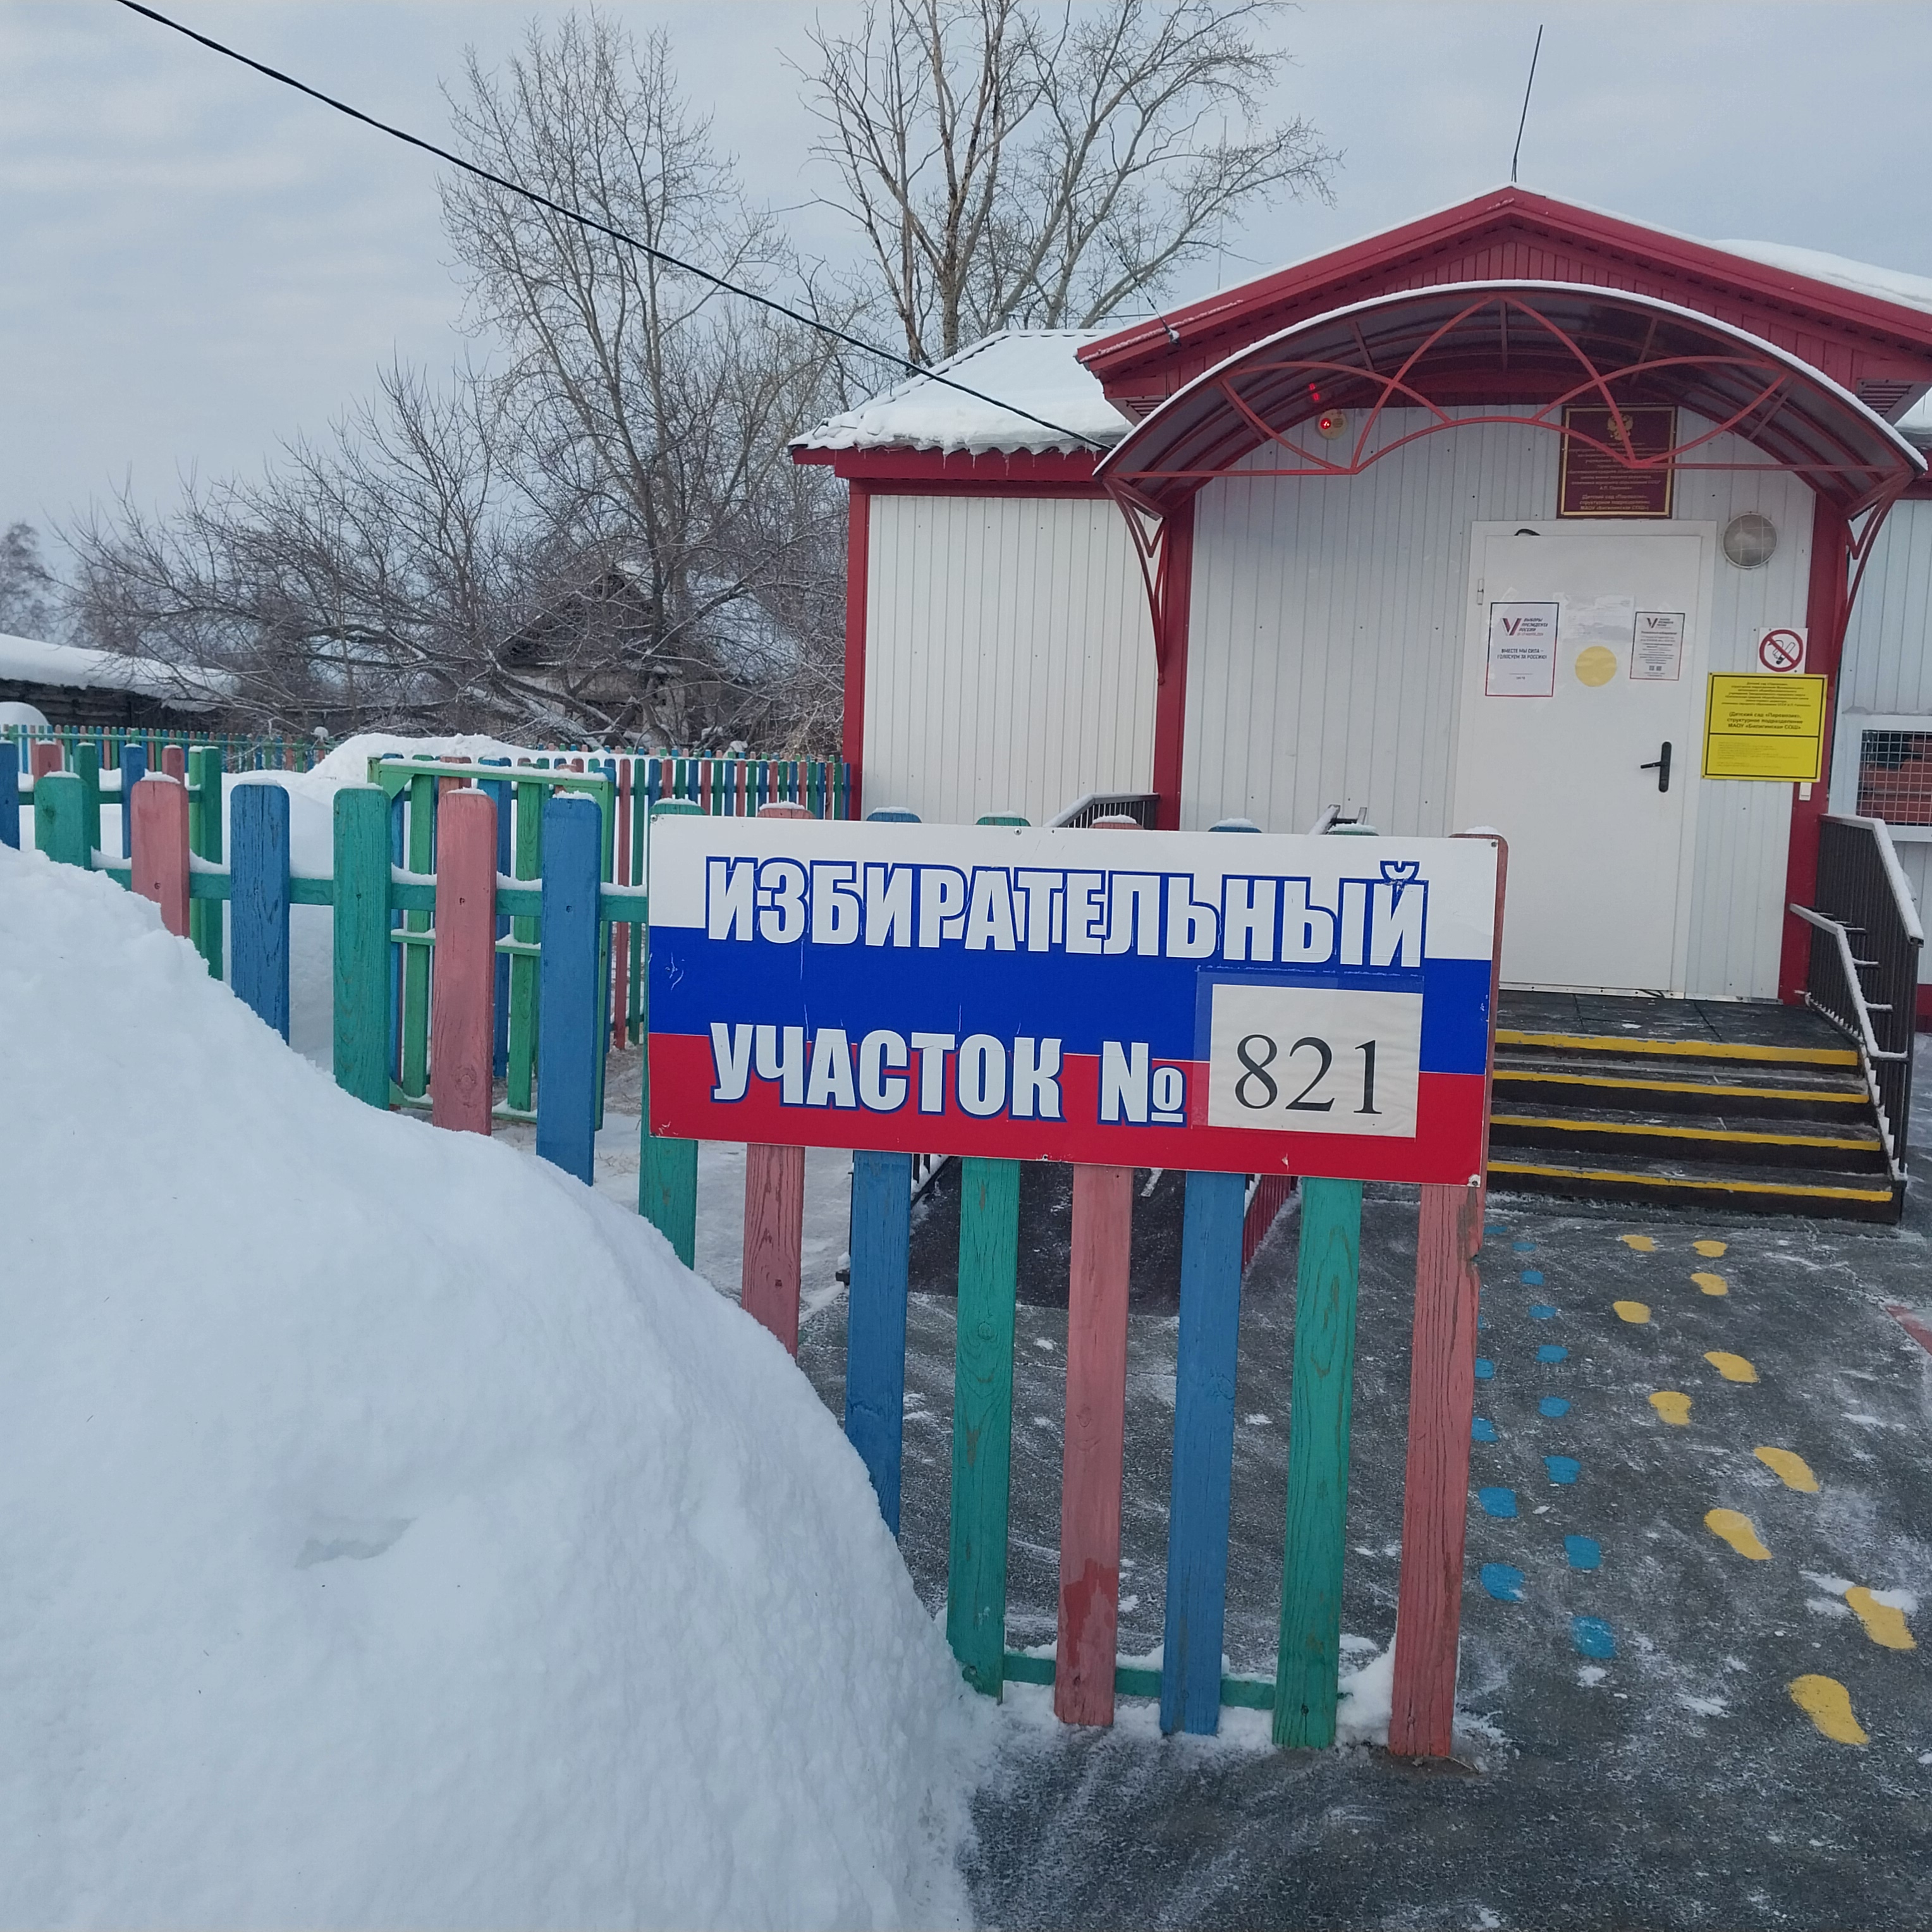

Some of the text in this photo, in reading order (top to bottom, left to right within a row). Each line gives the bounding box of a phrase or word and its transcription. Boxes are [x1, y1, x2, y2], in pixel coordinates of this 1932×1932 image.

[706, 856, 1429, 968] ИЗБИРАТЕЛЬНЫЙ
[709, 1021, 1383, 1126] УЧАСТОК № 821
